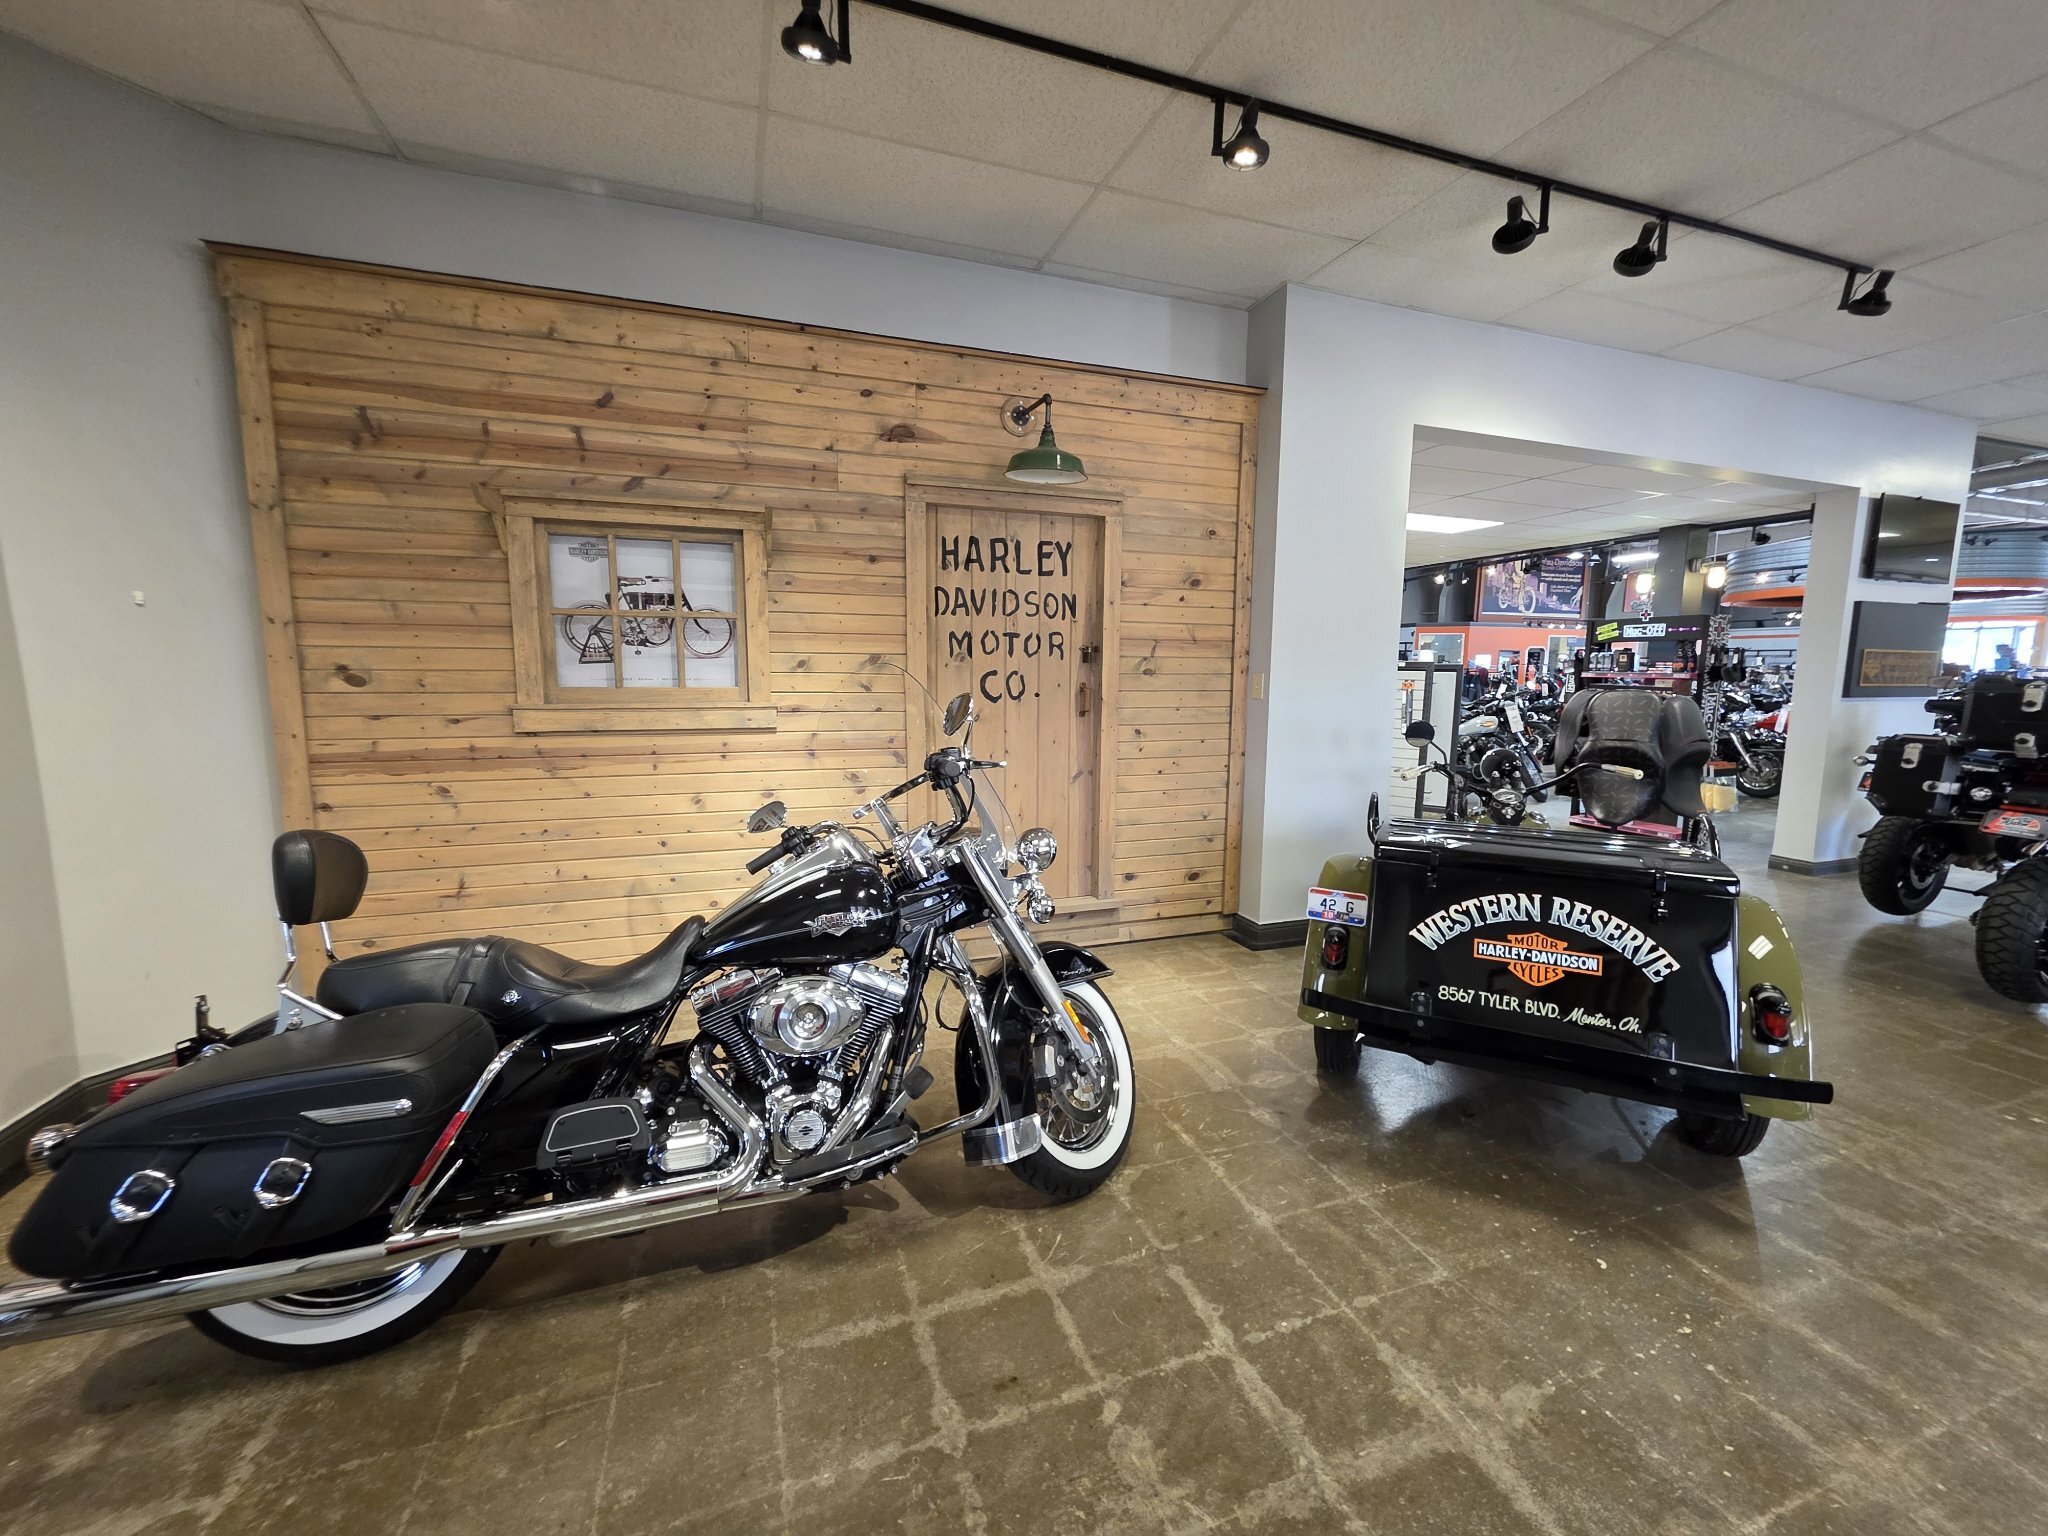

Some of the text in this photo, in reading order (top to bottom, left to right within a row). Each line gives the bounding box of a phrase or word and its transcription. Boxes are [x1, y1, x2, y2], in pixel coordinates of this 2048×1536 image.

[941, 535, 1072, 577] HARLEY
[934, 586, 1077, 621] DAVIDSON
[949, 629, 1064, 660] MOTOR
[1625, 624, 1665, 636] Muc-Off
[980, 669, 1040, 703] CO.
[1320, 898, 1355, 913] 42 G
[1409, 893, 1681, 983] WESTERN RESERVE
[1514, 934, 1559, 951] MOTOR
[1478, 942, 1598, 971] HARLEY-DAVIDSON
[1513, 962, 1560, 984] CYCLES
[1438, 985, 1475, 1004] 8567
[1478, 991, 1521, 1013] TYLER
[1525, 999, 1561, 1019] BLVD.
[1618, 1017, 1642, 1034] Oh.
